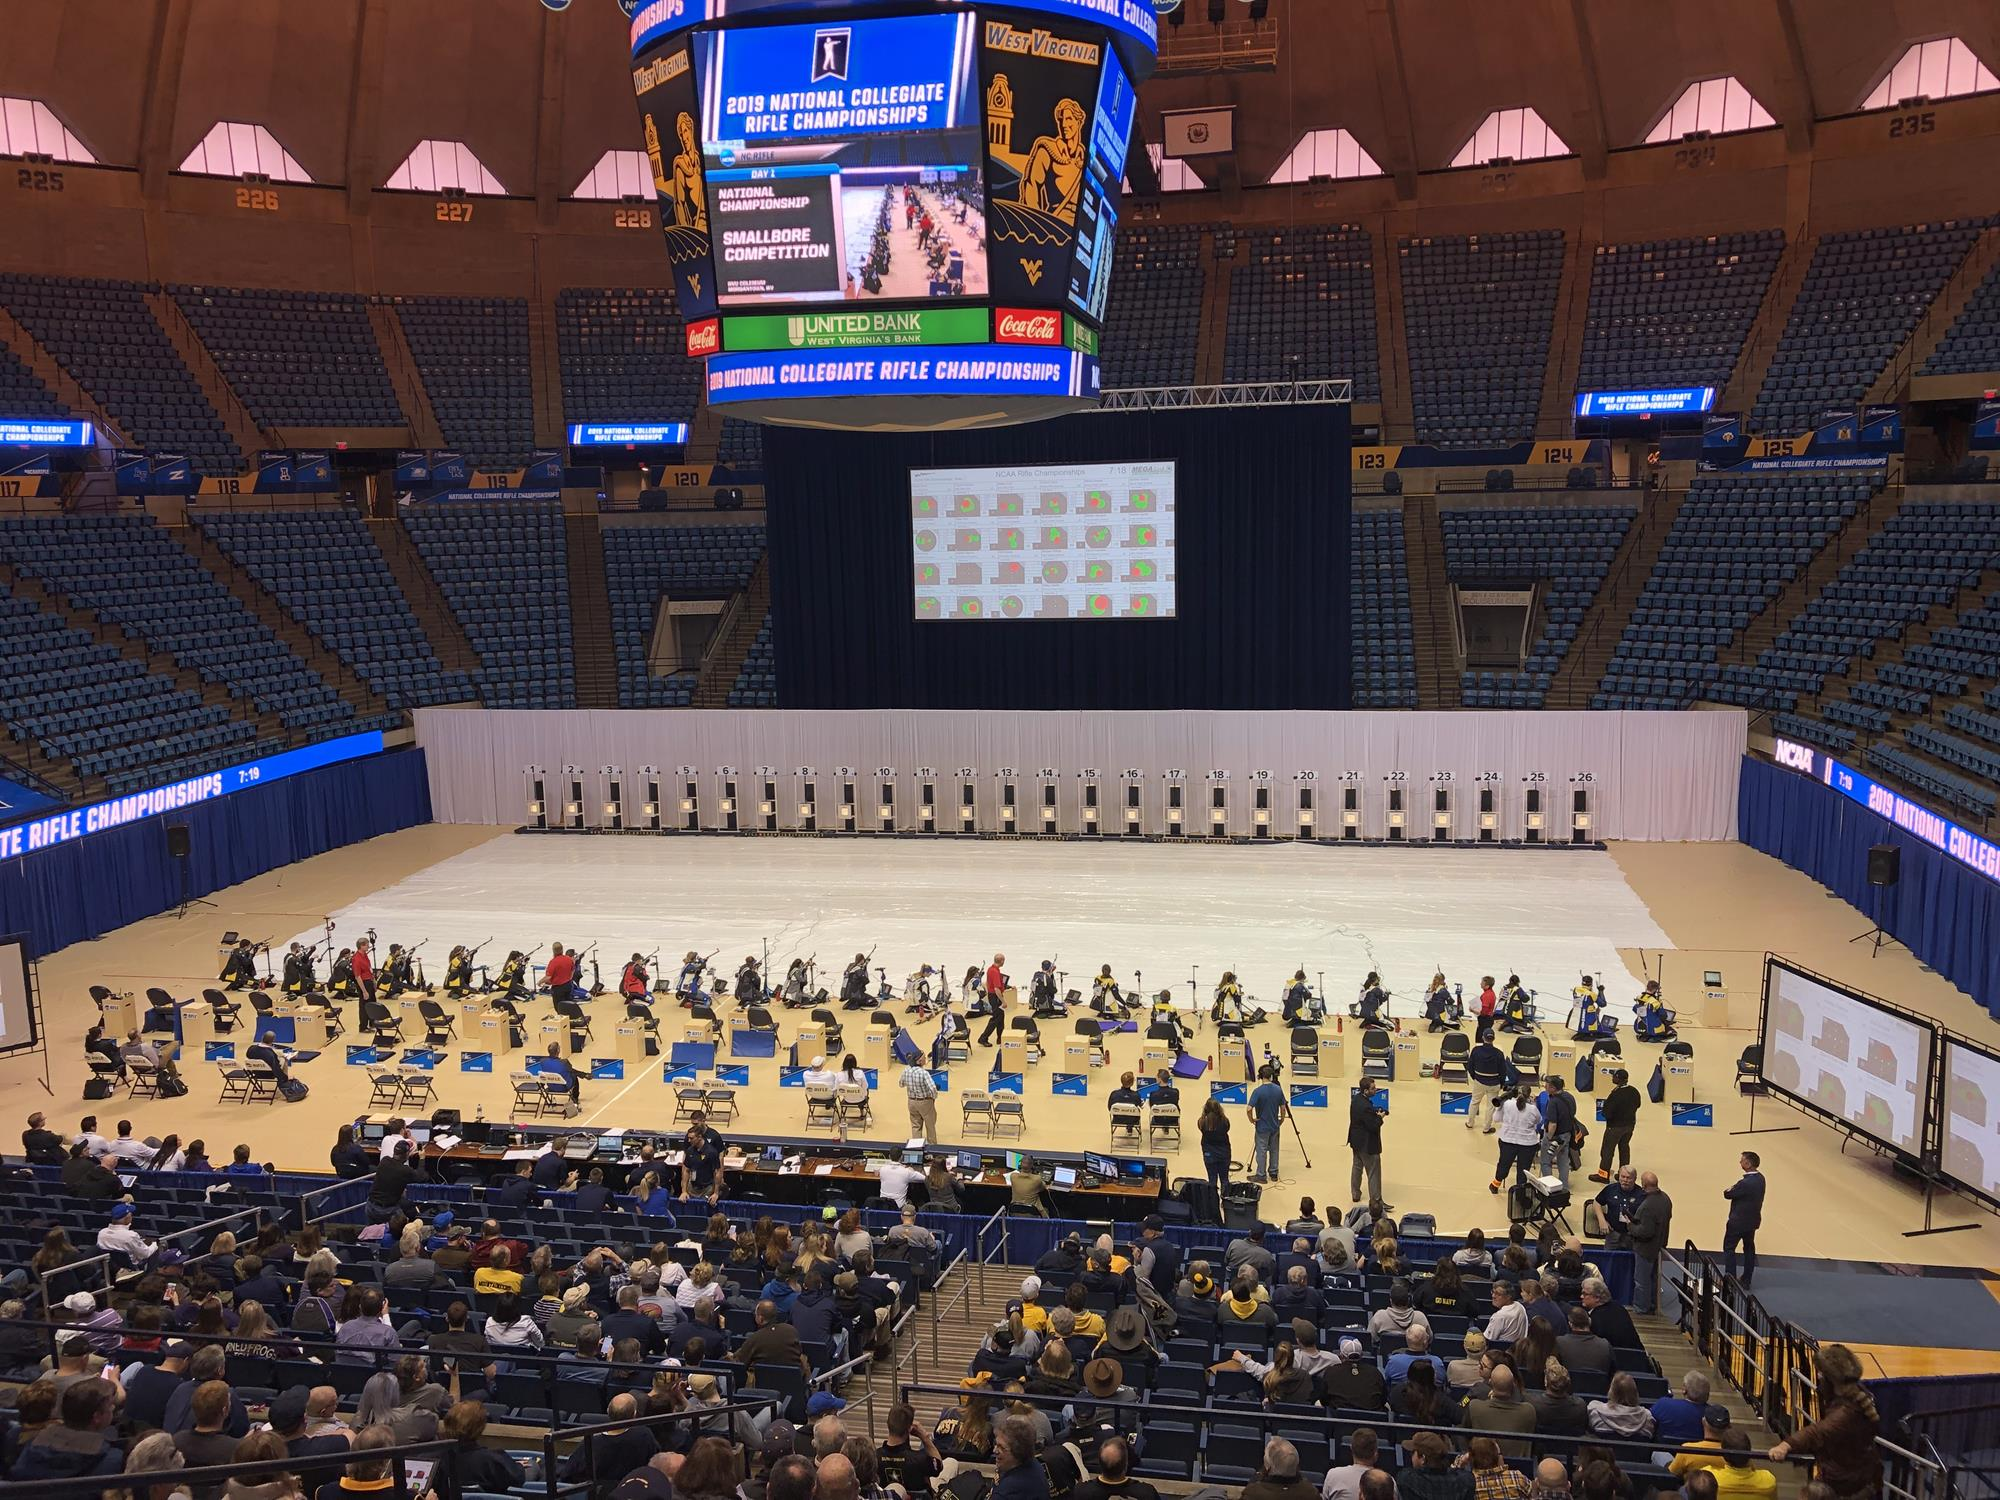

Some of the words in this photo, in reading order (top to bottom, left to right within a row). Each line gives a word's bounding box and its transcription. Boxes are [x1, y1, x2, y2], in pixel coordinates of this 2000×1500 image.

[988, 25, 1030, 51] WEST
[1031, 31, 1096, 62] VIRGINIA
[653, 53, 688, 83] VIRGINIA
[727, 96, 764, 115] 2019
[769, 90, 845, 113] NATIONAL
[851, 82, 945, 106] COLLEGIATE
[745, 113, 788, 133] RIFLE
[793, 105, 928, 130] CHAMPIONSHIPS
[1890, 112, 1935, 138] 235
[752, 151, 775, 160] RIFLE
[18, 168, 64, 192] 225
[751, 170, 768, 179] DAY
[236, 188, 279, 210] 226
[719, 186, 775, 199] NATIONAL
[720, 196, 810, 212] CHAMPIONSHIP
[436, 203, 473, 222] 227
[615, 210, 651, 228] 228
[723, 228, 811, 245] SMALLBORE
[725, 243, 829, 261] COMPETITION
[805, 315, 869, 333] UNITED
[874, 313, 922, 331] BANK
[1000, 314, 1057, 339] Coca-Cola
[807, 336, 835, 344] WEST
[840, 334, 891, 344] VIRGINIA'S
[895, 334, 921, 343] BANK
[724, 366, 775, 387] NATIONAL
[780, 362, 874, 384] COLLEGIATE
[880, 361, 930, 381] RIFLE
[935, 361, 1060, 382] CHAMPIONSHIPS
[1616, 395, 1649, 403] NATIONAL
[1651, 393, 1692, 402] COLLEGIATE
[1605, 403, 1624, 411] RIFLE
[1625, 401, 1684, 410] CHAMPIONSHIPS
[1544, 448, 1572, 463] 124
[1764, 441, 1793, 456] 125
[1358, 455, 1385, 469] 123
[1780, 460, 1814, 468] COLLEGIATE
[1833, 458, 1887, 466] CHAMPIONSHIPS
[674, 472, 700, 486] 120
[1034, 469, 1085, 477] Championships
[217, 480, 239, 494] 118
[486, 476, 507, 488] 119
[1775, 739, 1814, 772] NCAA
[239, 767, 260, 783] 7:19
[879, 768, 890, 776] 10
[921, 768, 930, 776] 11
[1042, 769, 1053, 777] 14
[1084, 769, 1095, 777] 15
[1126, 770, 1138, 778] 16
[1169, 770, 1179, 778] 17
[1213, 770, 1224, 778] 18
[1257, 771, 1268, 779] 19
[1300, 771, 1314, 780] 20
[1347, 772, 1358, 780] 21
[1391, 772, 1405, 780] 22
[1437, 772, 1451, 781] 23
[1484, 773, 1499, 781] 24
[1530, 773, 1545, 781] 25
[1578, 773, 1593, 782] 26
[1839, 771, 1853, 790] 7:19
[29, 812, 81, 849] RIFLE
[87, 773, 222, 831] CHAMPIONSHIPS
[1869, 784, 1894, 817] 2019
[1895, 797, 1946, 849] NATIONAL
[1949, 827, 2000, 880] COLLEGI
